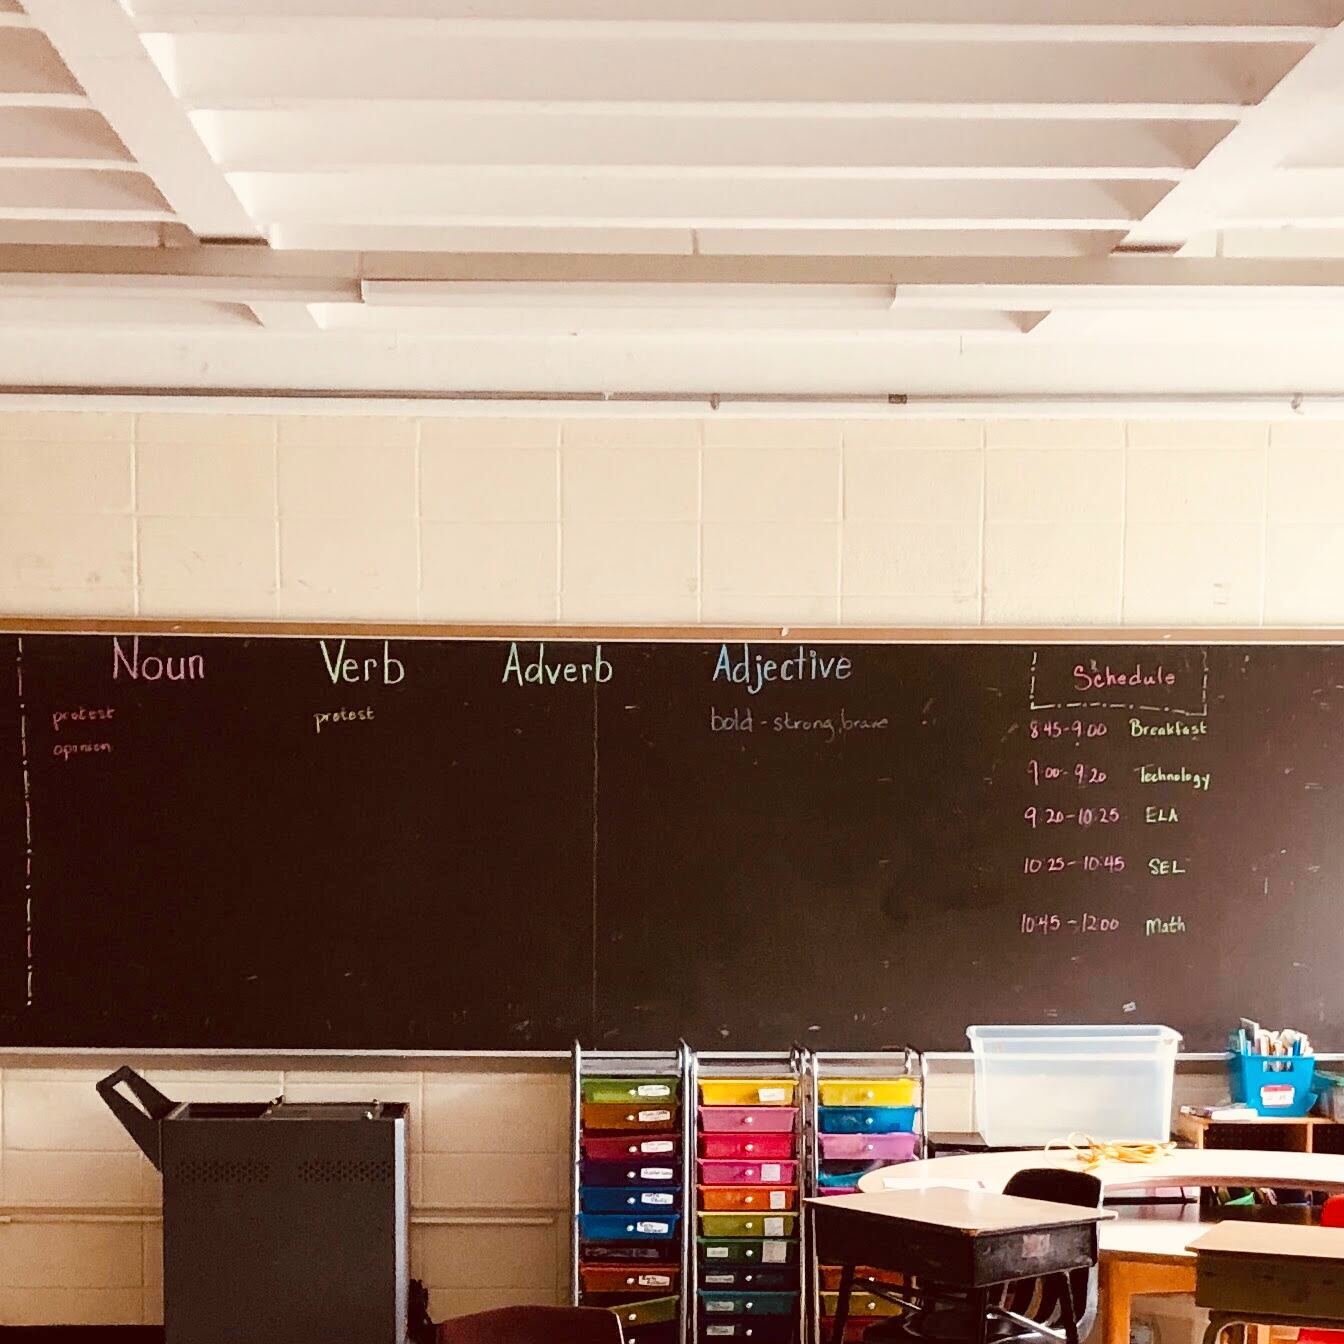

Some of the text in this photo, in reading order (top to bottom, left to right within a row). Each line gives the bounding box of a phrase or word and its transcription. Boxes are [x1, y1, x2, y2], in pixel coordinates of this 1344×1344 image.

[113, 636, 205, 681] Noun
[320, 639, 405, 685] Verb
[502, 642, 613, 686] Adverb
[712, 642, 852, 694] Adjective
[1074, 664, 1175, 691] Schedule
[53, 708, 116, 729] protest
[313, 706, 375, 733] protest
[711, 706, 753, 732] bold
[1128, 718, 1207, 737] Breakfast
[1134, 764, 1211, 791] Technology
[1146, 806, 1179, 824] ELA
[1148, 858, 1186, 875] SEL
